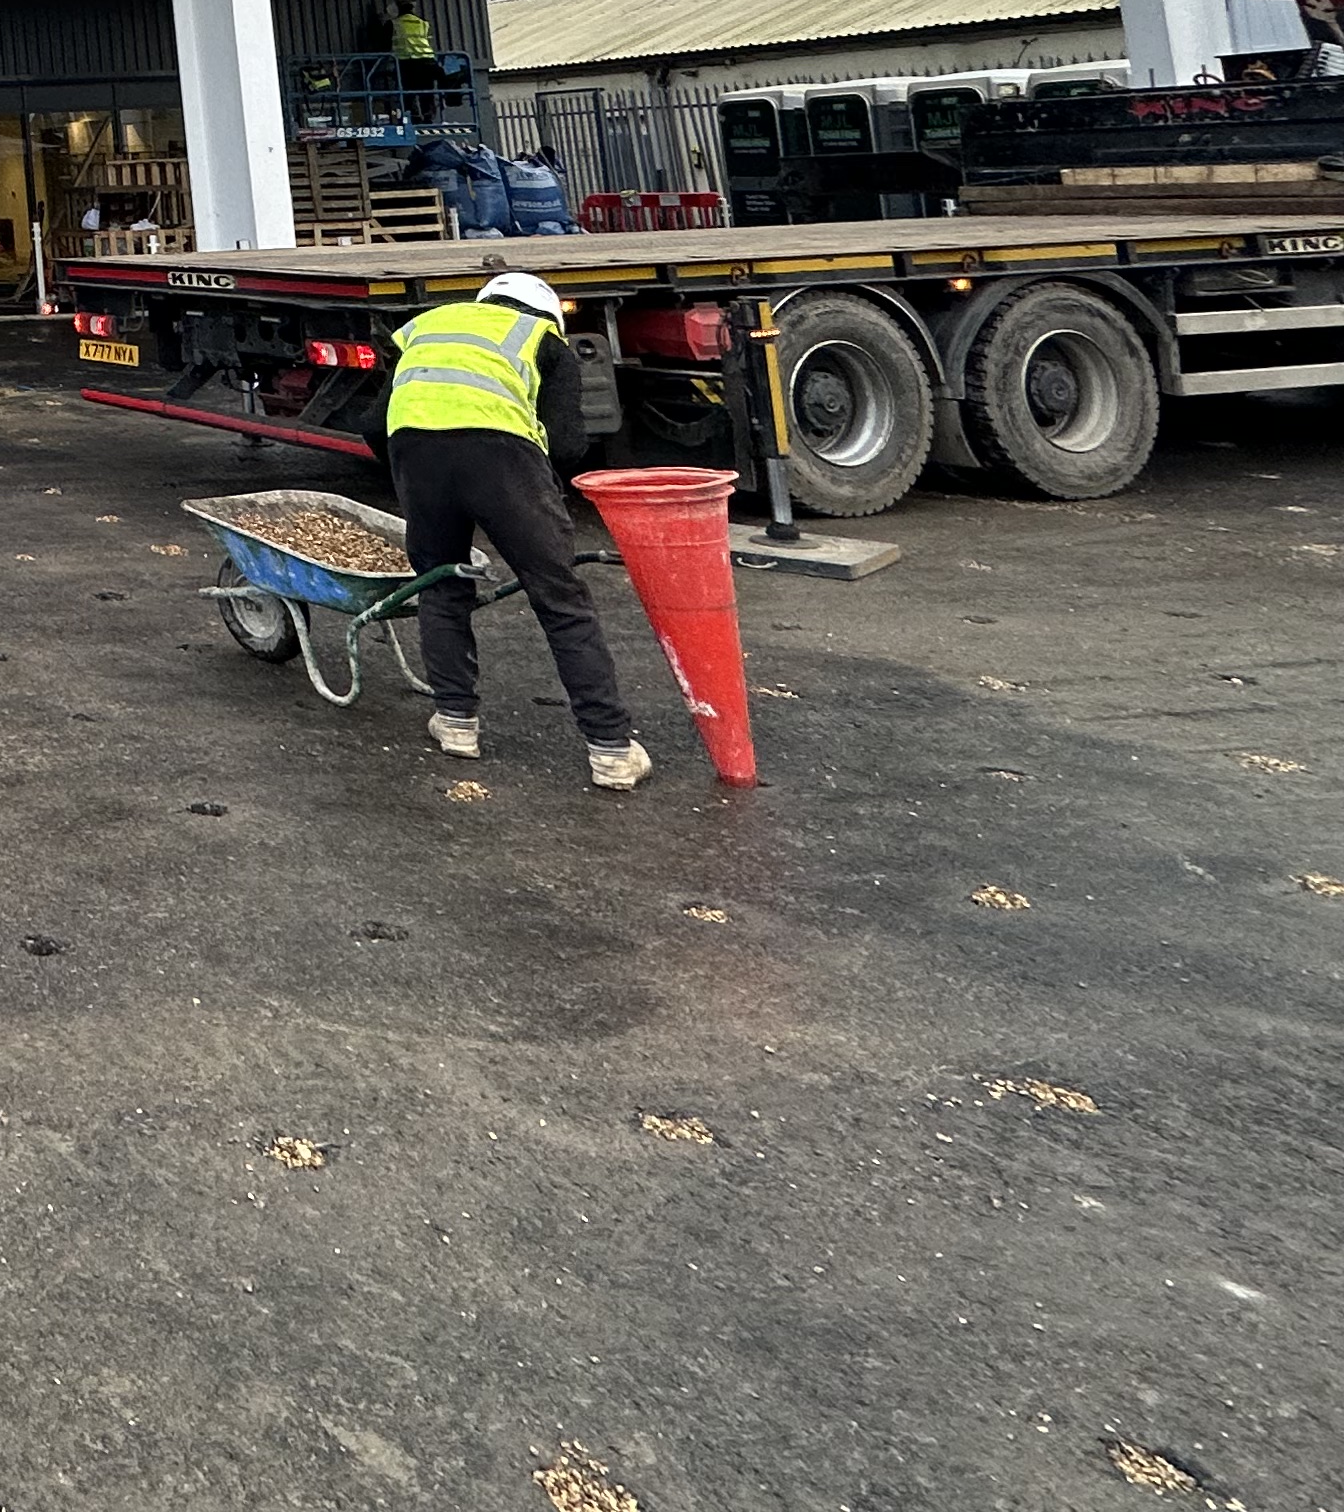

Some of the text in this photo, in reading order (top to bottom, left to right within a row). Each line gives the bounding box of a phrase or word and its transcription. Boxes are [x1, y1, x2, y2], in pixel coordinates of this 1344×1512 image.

[336, 126, 386, 139] GS-1932
[1268, 236, 1342, 253] KING
[170, 272, 232, 288] KING
[83, 343, 135, 364] X777 NYA
